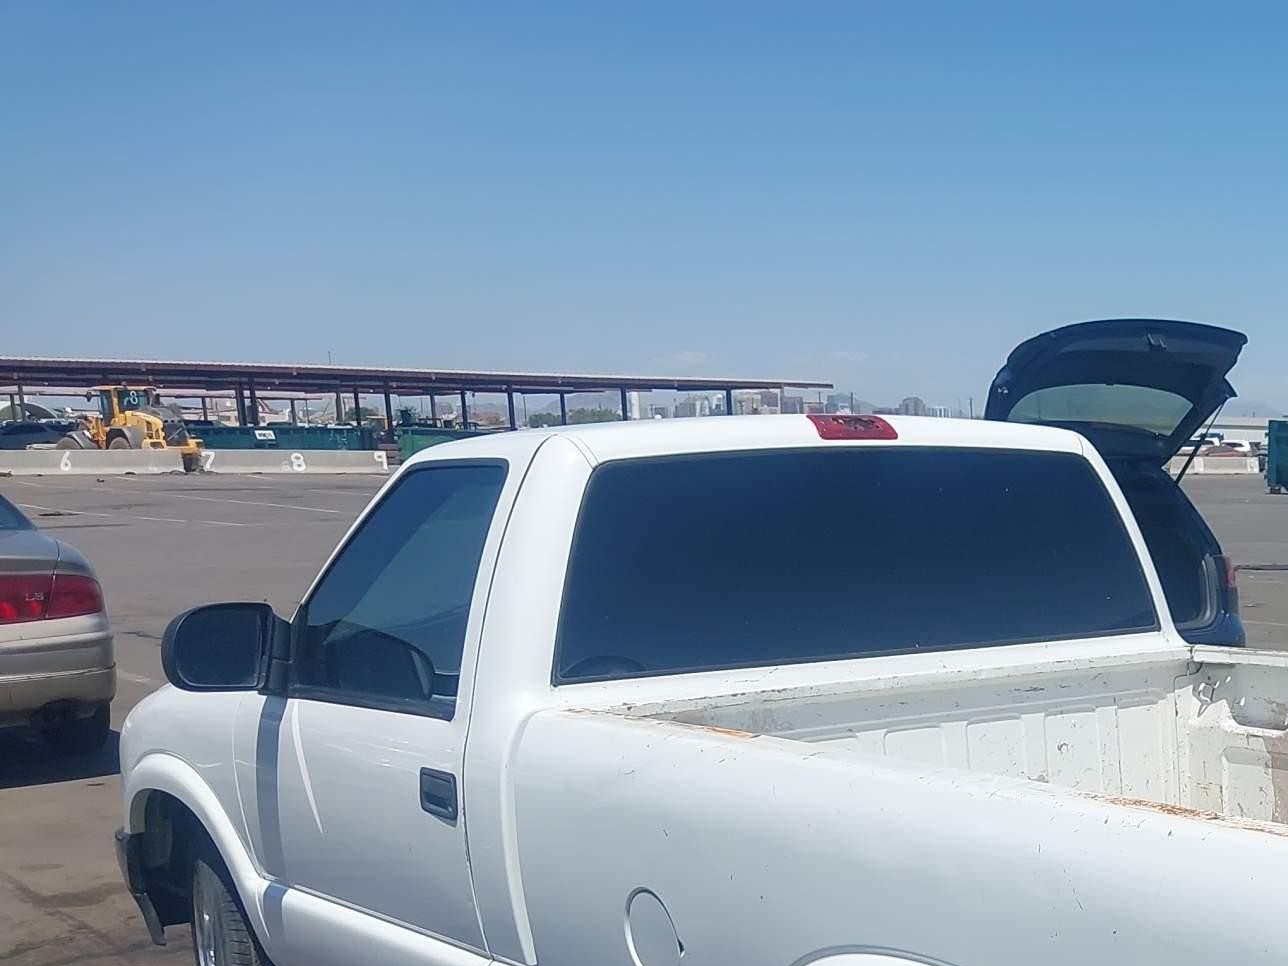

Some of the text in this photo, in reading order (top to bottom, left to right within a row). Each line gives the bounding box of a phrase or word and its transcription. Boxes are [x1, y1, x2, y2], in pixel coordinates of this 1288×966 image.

[59, 451, 72, 472] 6
[200, 450, 216, 470] 7
[290, 452, 307, 472] 8
[373, 450, 389, 471] 9
